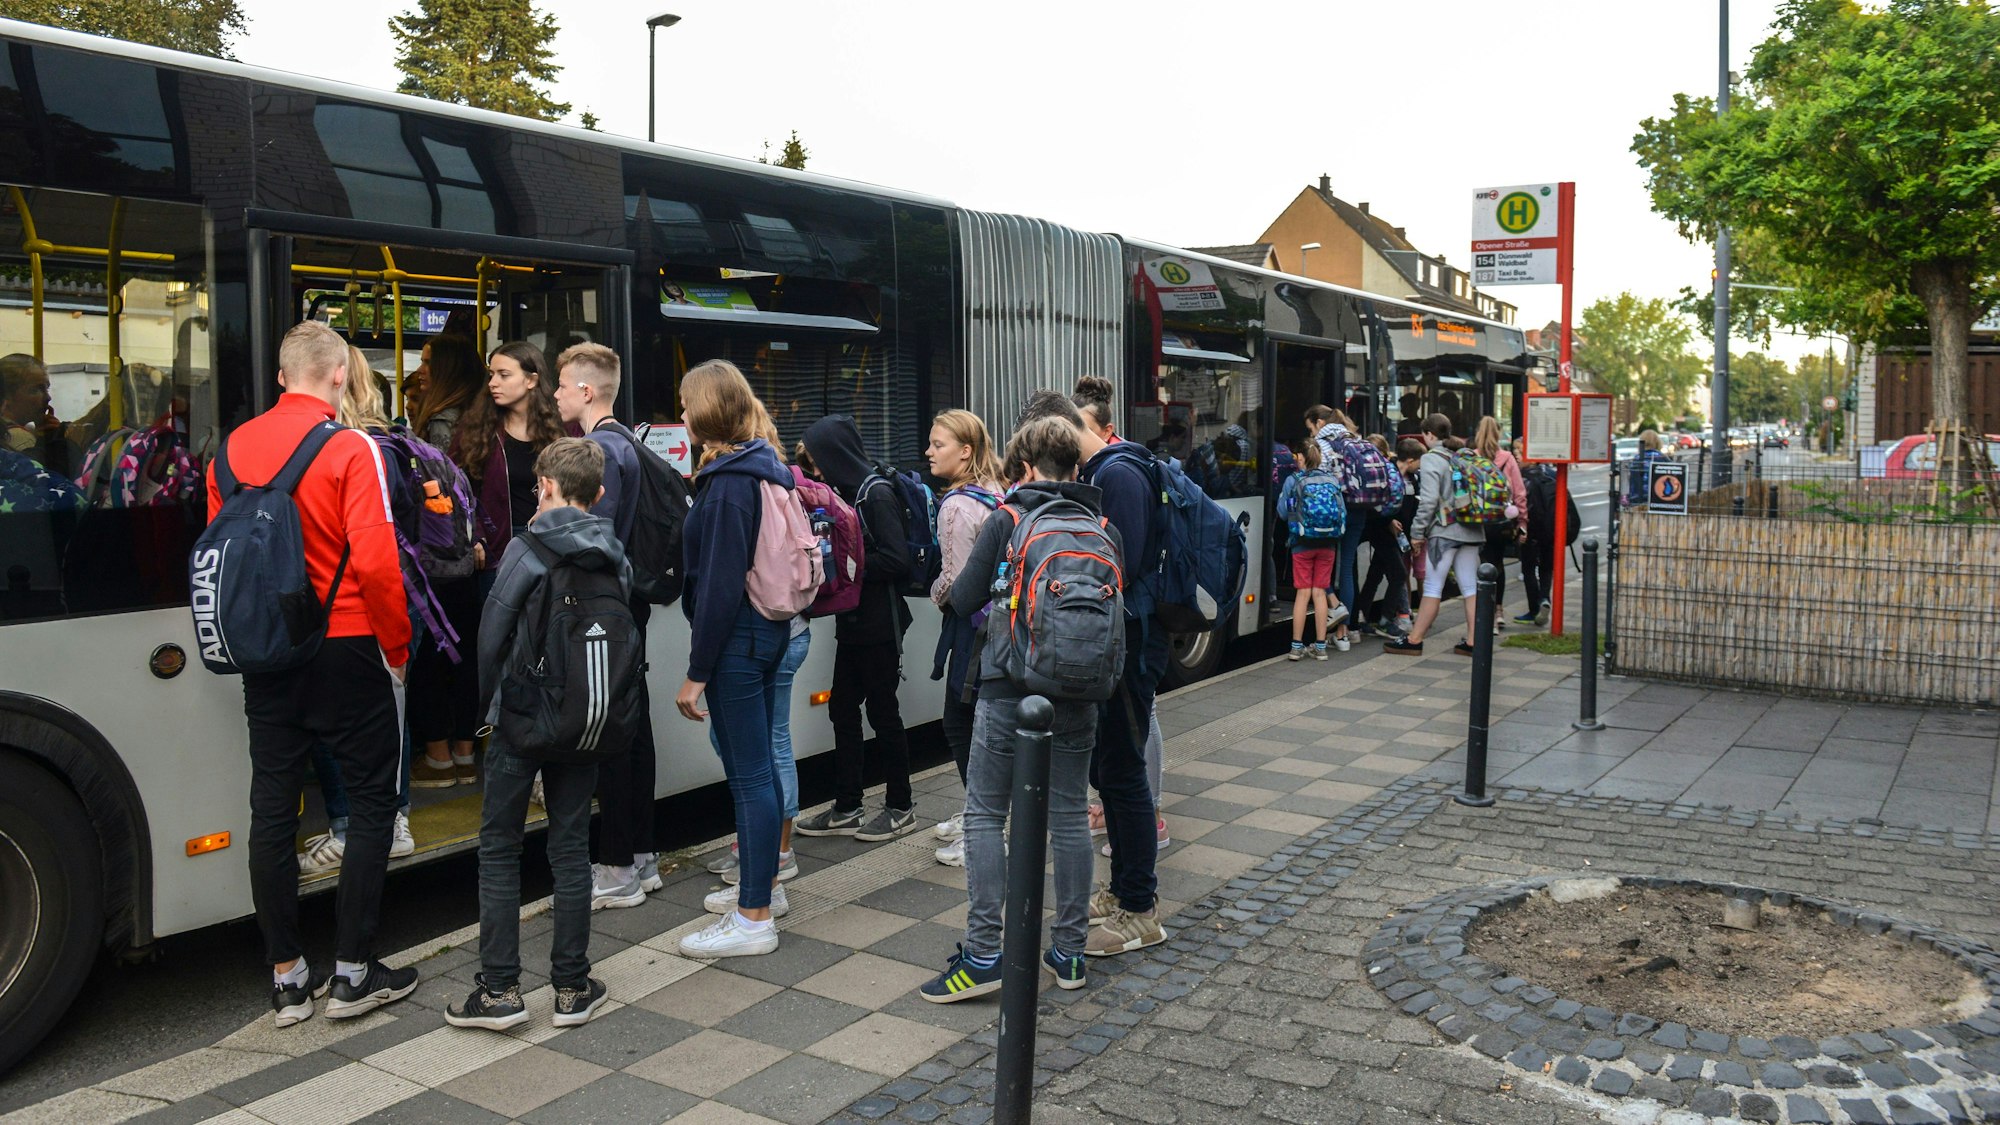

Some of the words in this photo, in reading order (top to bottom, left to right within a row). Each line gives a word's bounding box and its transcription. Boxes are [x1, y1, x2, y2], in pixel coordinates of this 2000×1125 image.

[1508, 200, 1527, 225] H
[1475, 242, 1503, 250] Olpener
[1477, 256, 1494, 265] 154
[1477, 272, 1494, 281] 187
[427, 312, 445, 325] the
[192, 548, 228, 664] ADIDAS
